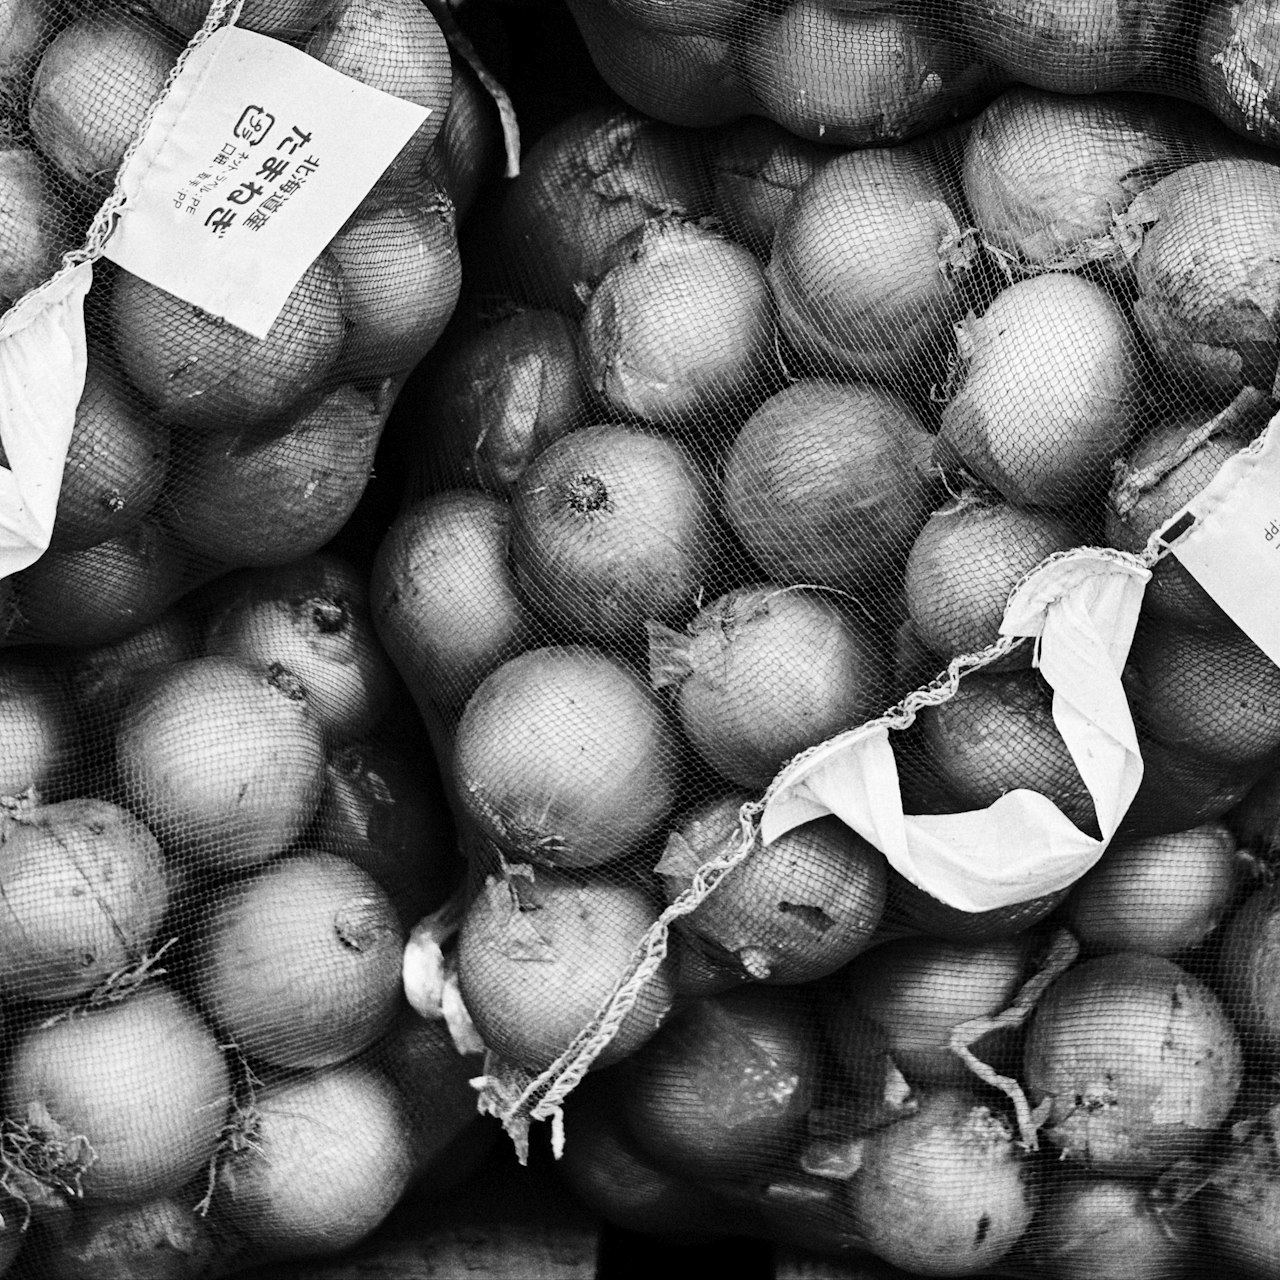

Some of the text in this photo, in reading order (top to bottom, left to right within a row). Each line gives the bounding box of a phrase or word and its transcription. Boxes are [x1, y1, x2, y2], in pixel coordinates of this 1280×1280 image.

[205, 125, 313, 239] たまねぎ
[242, 155, 320, 231] 北海道産
